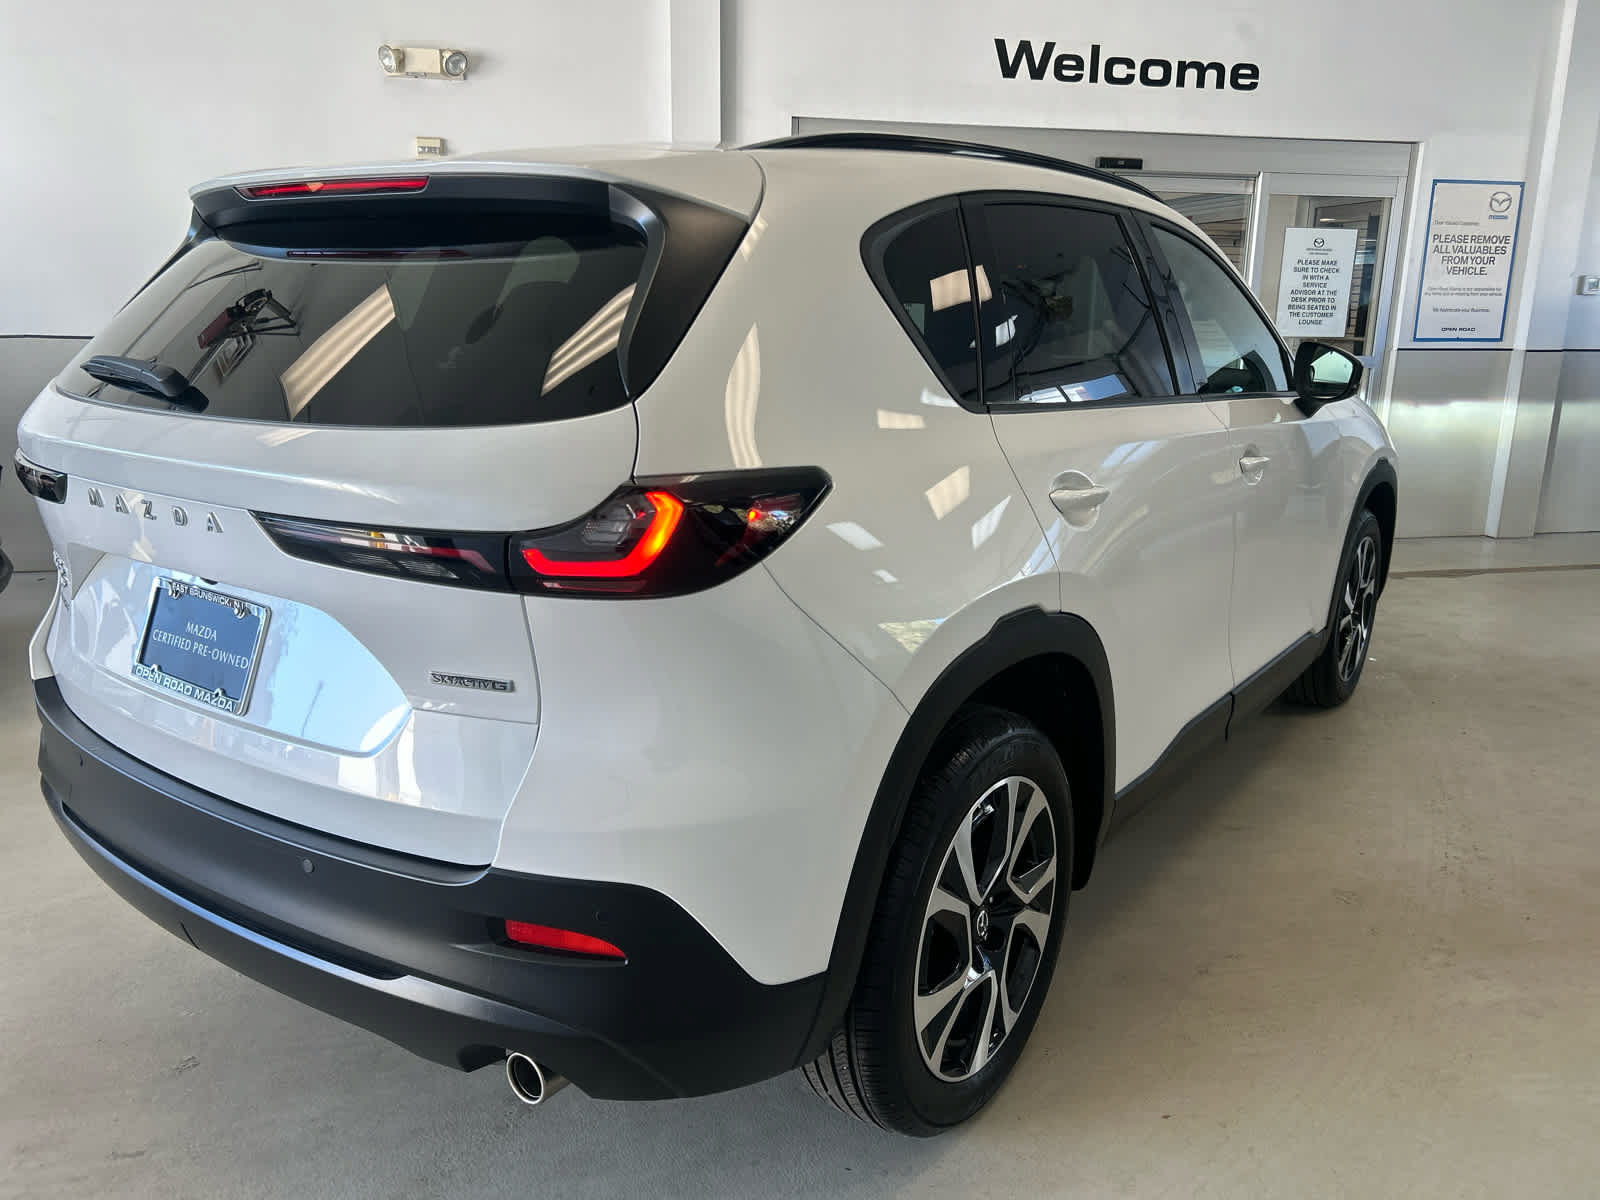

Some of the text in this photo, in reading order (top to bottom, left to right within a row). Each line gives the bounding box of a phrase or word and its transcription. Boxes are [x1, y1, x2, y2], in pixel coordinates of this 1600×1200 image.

[994, 38, 1260, 91] Welcome
[1432, 234, 1511, 245] PLEASE REMOVE
[1432, 244, 1507, 255] ALL VALUABLES
[1441, 255, 1496, 265] FROM YOUR
[1446, 266, 1488, 276] VEHICLE.
[87, 487, 224, 533] MAZDA
[185, 621, 217, 641] MAZDA
[152, 629, 249, 669] CERTIFIED PRE-OWNED
[135, 666, 234, 712] OPEN ROAD MAZDA
